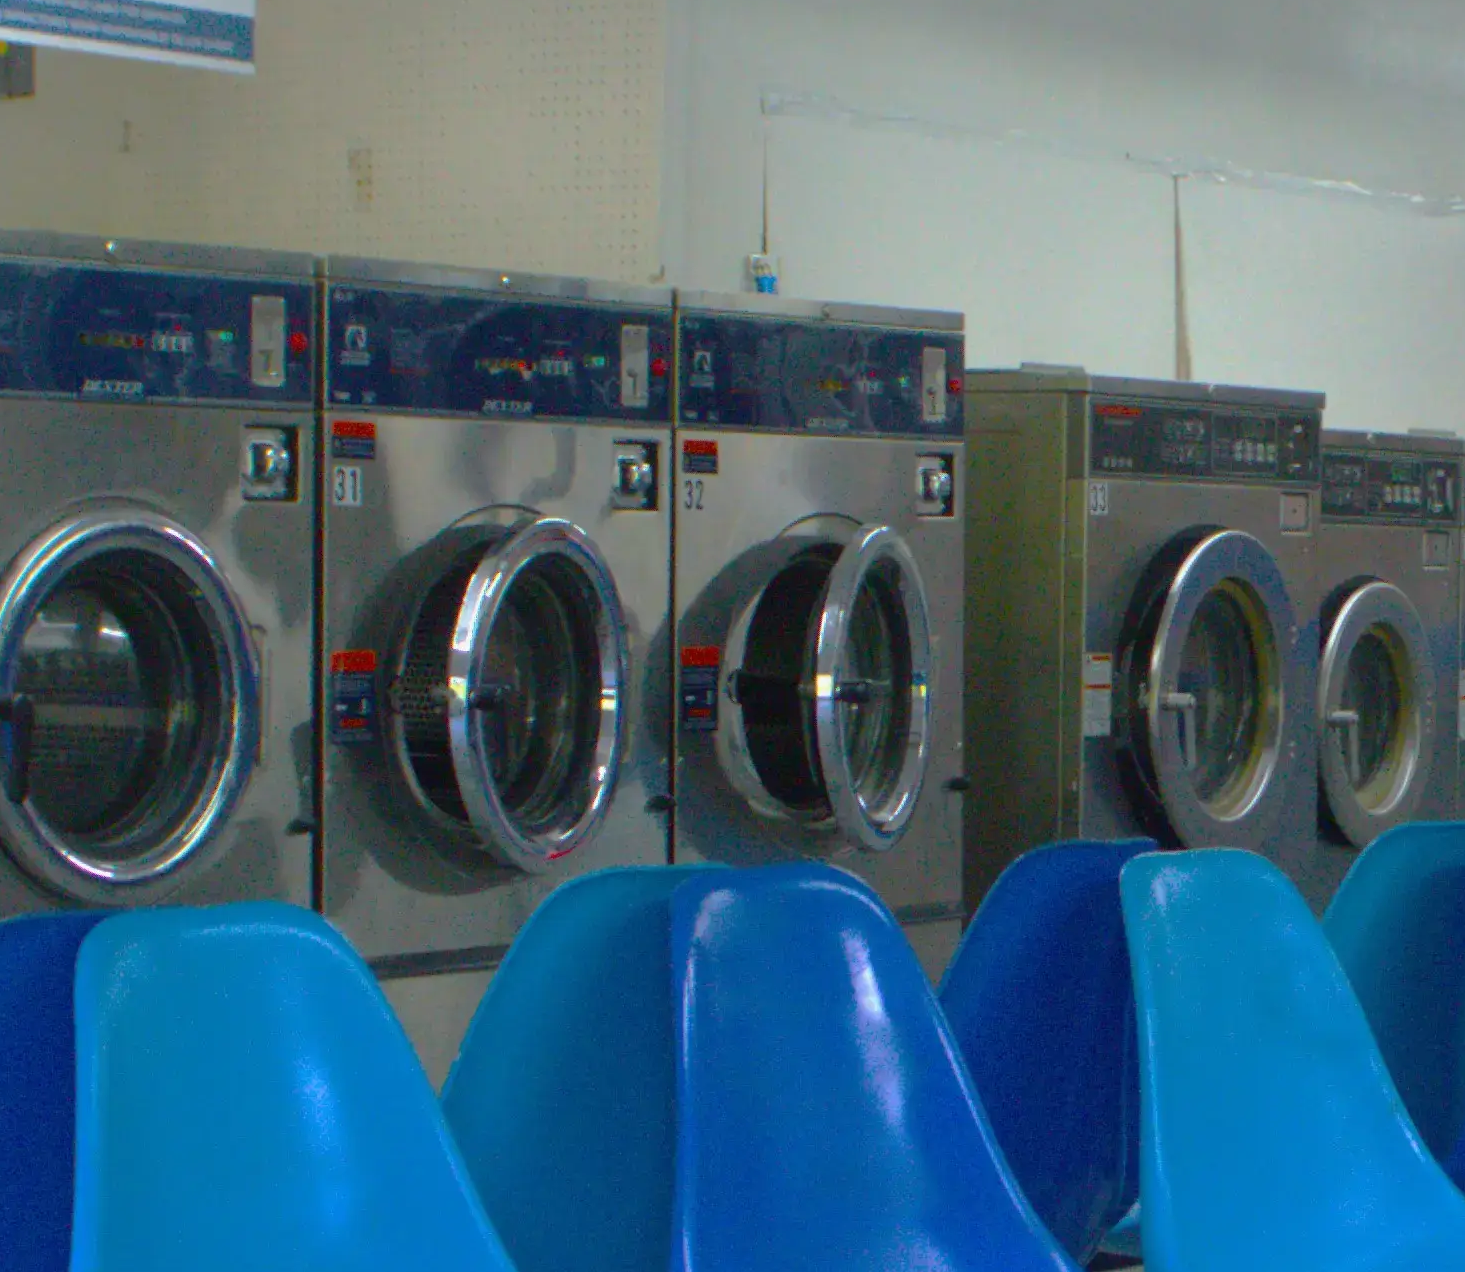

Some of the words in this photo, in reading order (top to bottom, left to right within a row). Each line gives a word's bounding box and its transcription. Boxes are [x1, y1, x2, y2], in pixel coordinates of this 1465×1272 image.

[335, 466, 357, 504] 31
[684, 479, 705, 511] 32
[1091, 483, 1107, 513] 33
